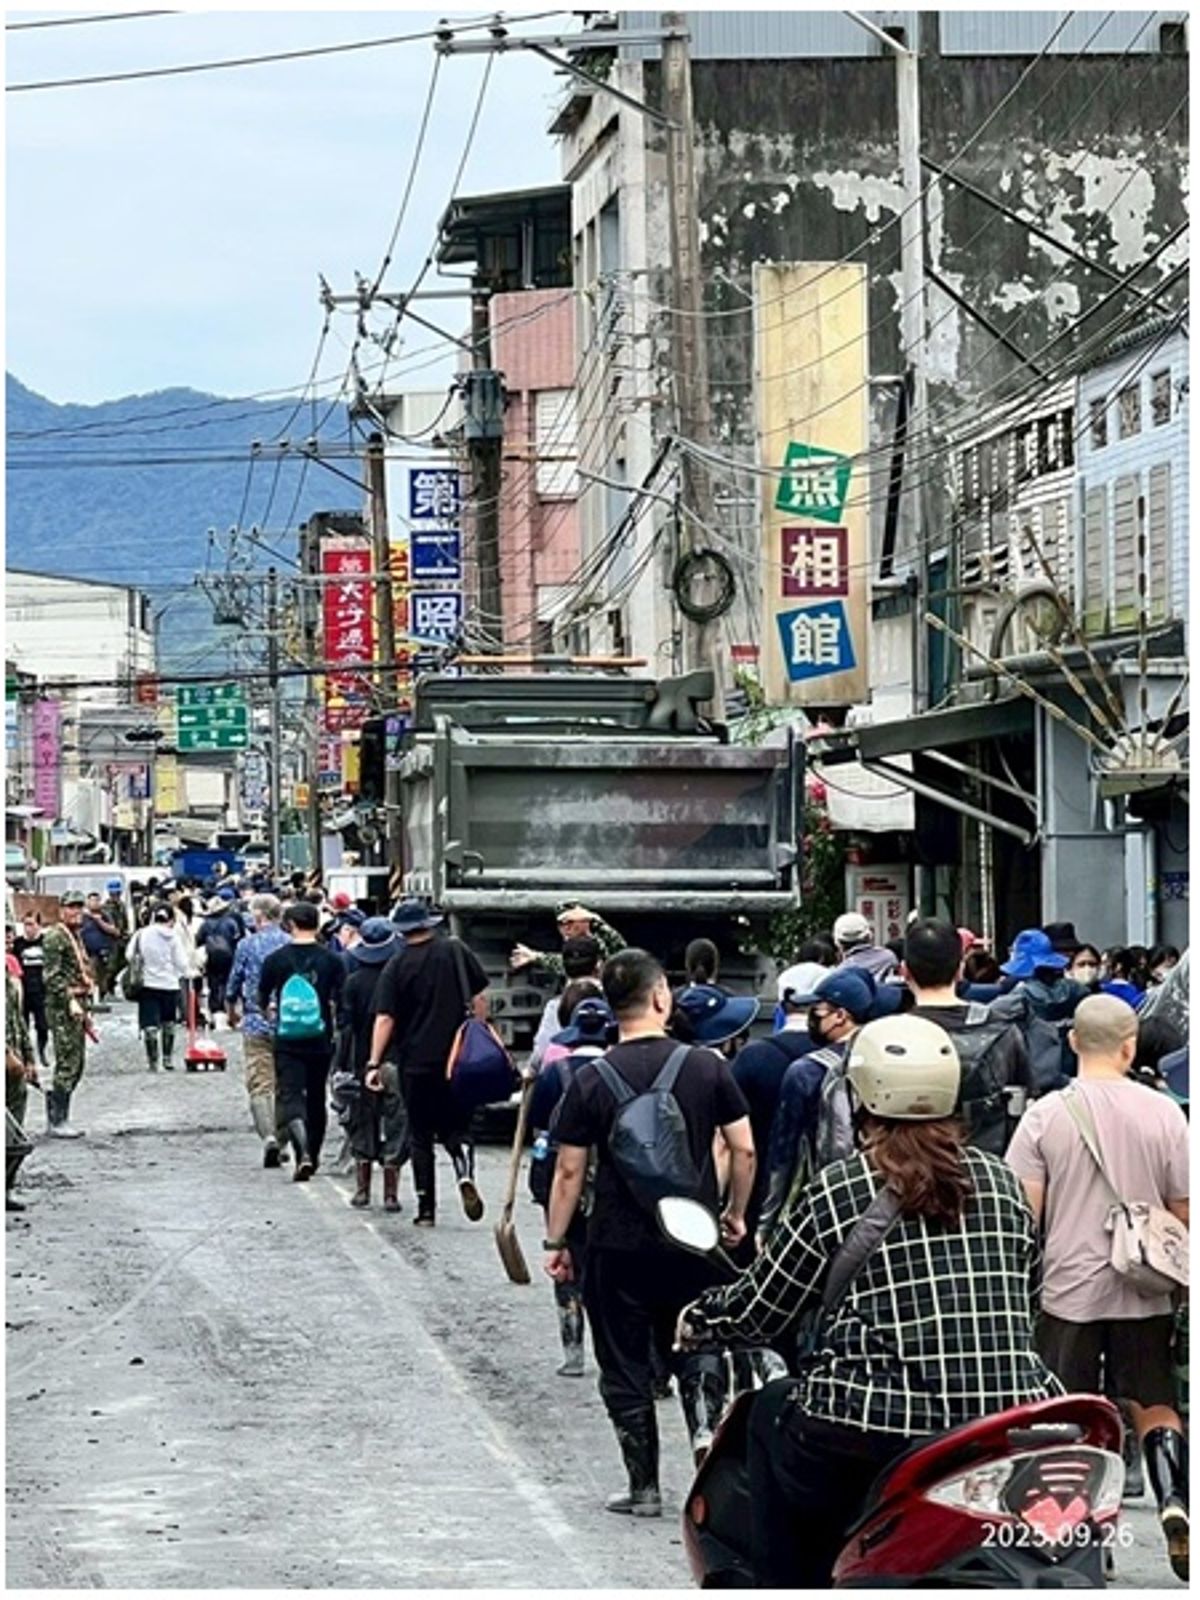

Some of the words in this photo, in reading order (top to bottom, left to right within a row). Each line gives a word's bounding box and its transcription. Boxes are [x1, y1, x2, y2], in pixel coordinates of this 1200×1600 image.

[412, 470, 460, 676] 第二照
[788, 454, 843, 666] 照相館
